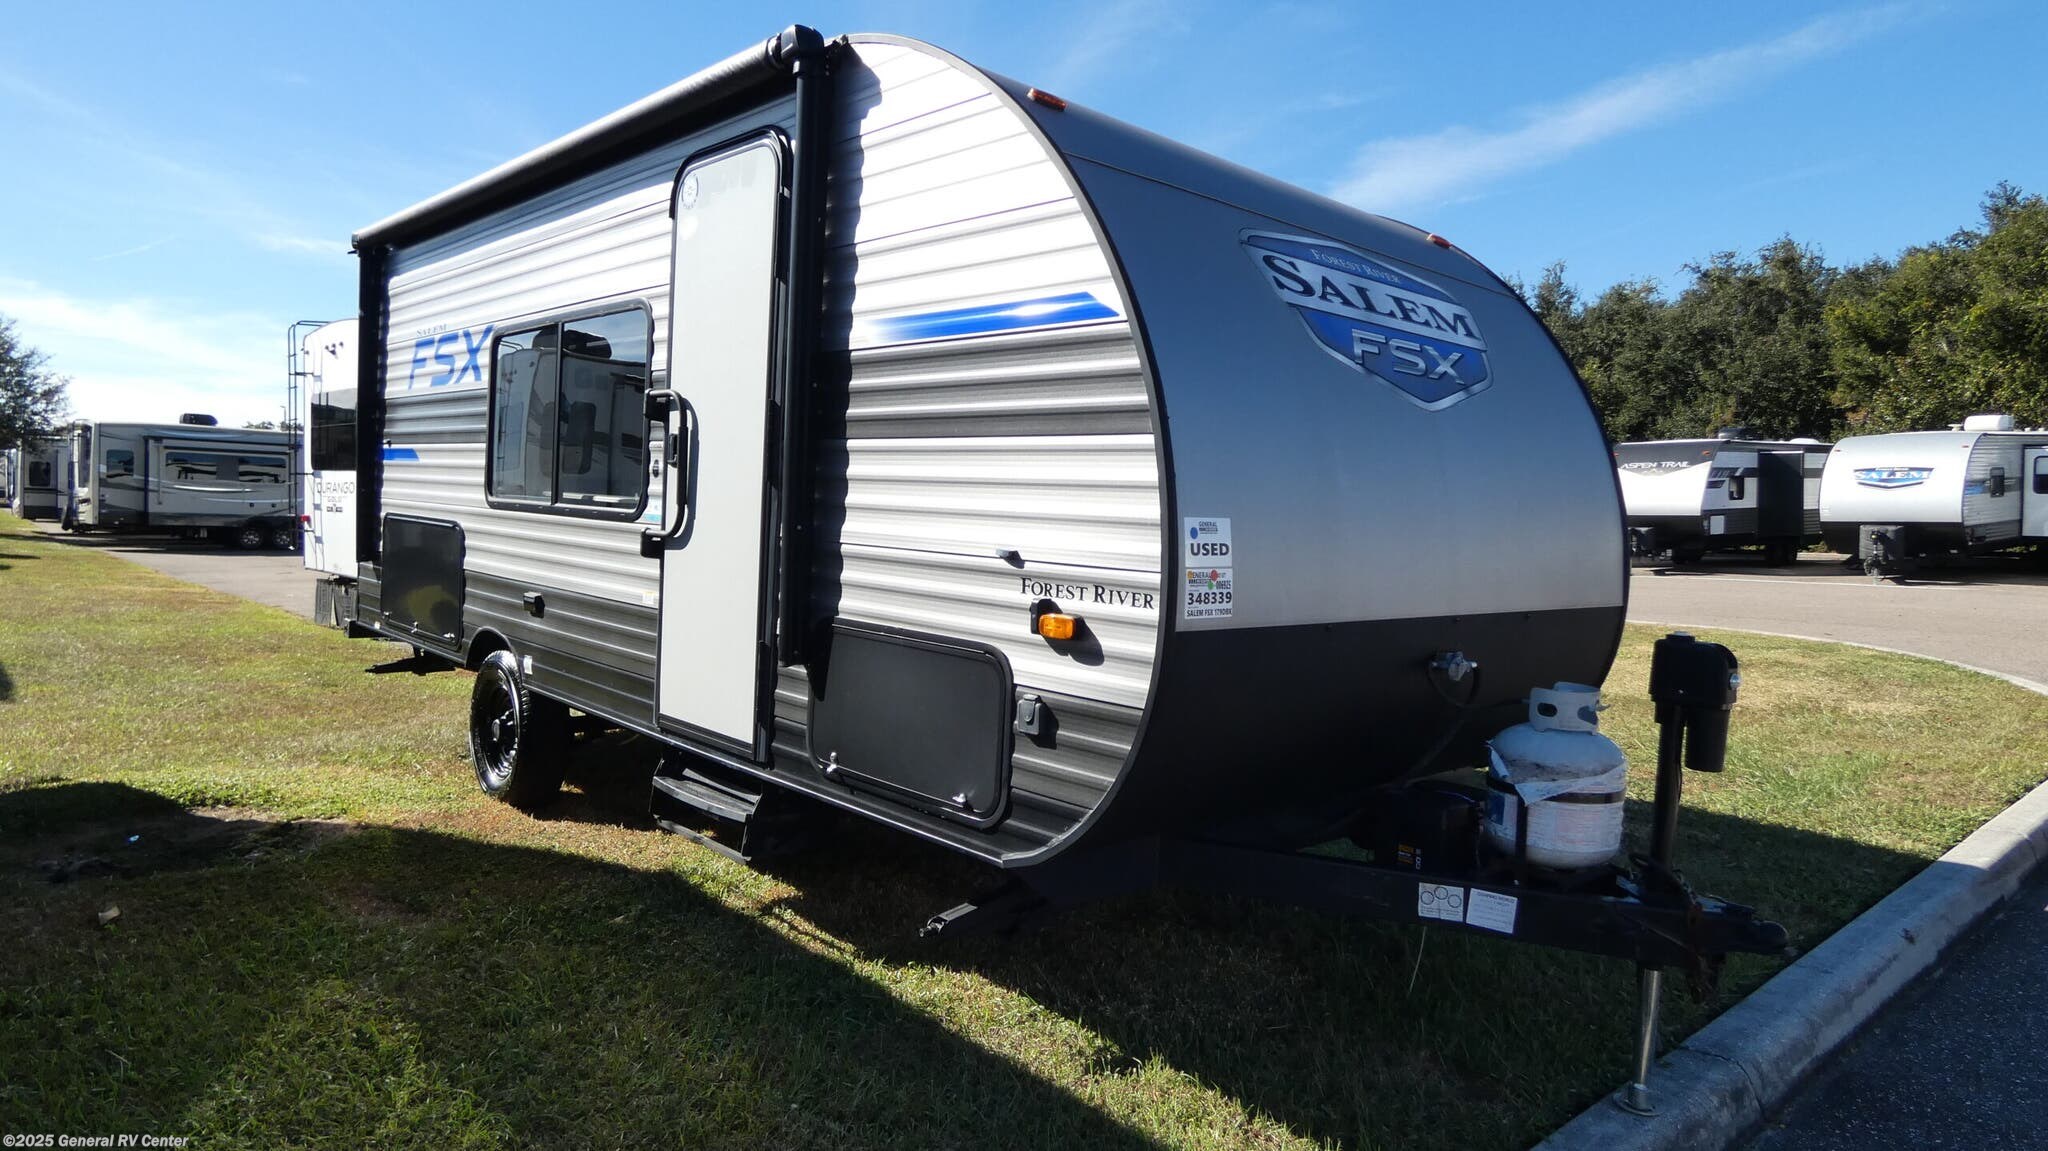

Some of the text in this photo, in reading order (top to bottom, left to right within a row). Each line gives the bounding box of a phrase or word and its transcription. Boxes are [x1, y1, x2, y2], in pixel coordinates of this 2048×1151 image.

[1311, 248, 1401, 283] FOREST RIVER
[1263, 254, 1482, 342] SALEM
[408, 324, 495, 390] FSX
[1351, 328, 1466, 385] FSX
[1854, 470, 1930, 480] SALEM
[316, 481, 355, 494] DURANGO
[1190, 542, 1230, 556] USED
[1021, 577, 1155, 610] FOREST RIVER
[1187, 591, 1232, 606] 348339
[1186, 609, 1204, 617] SALEM
